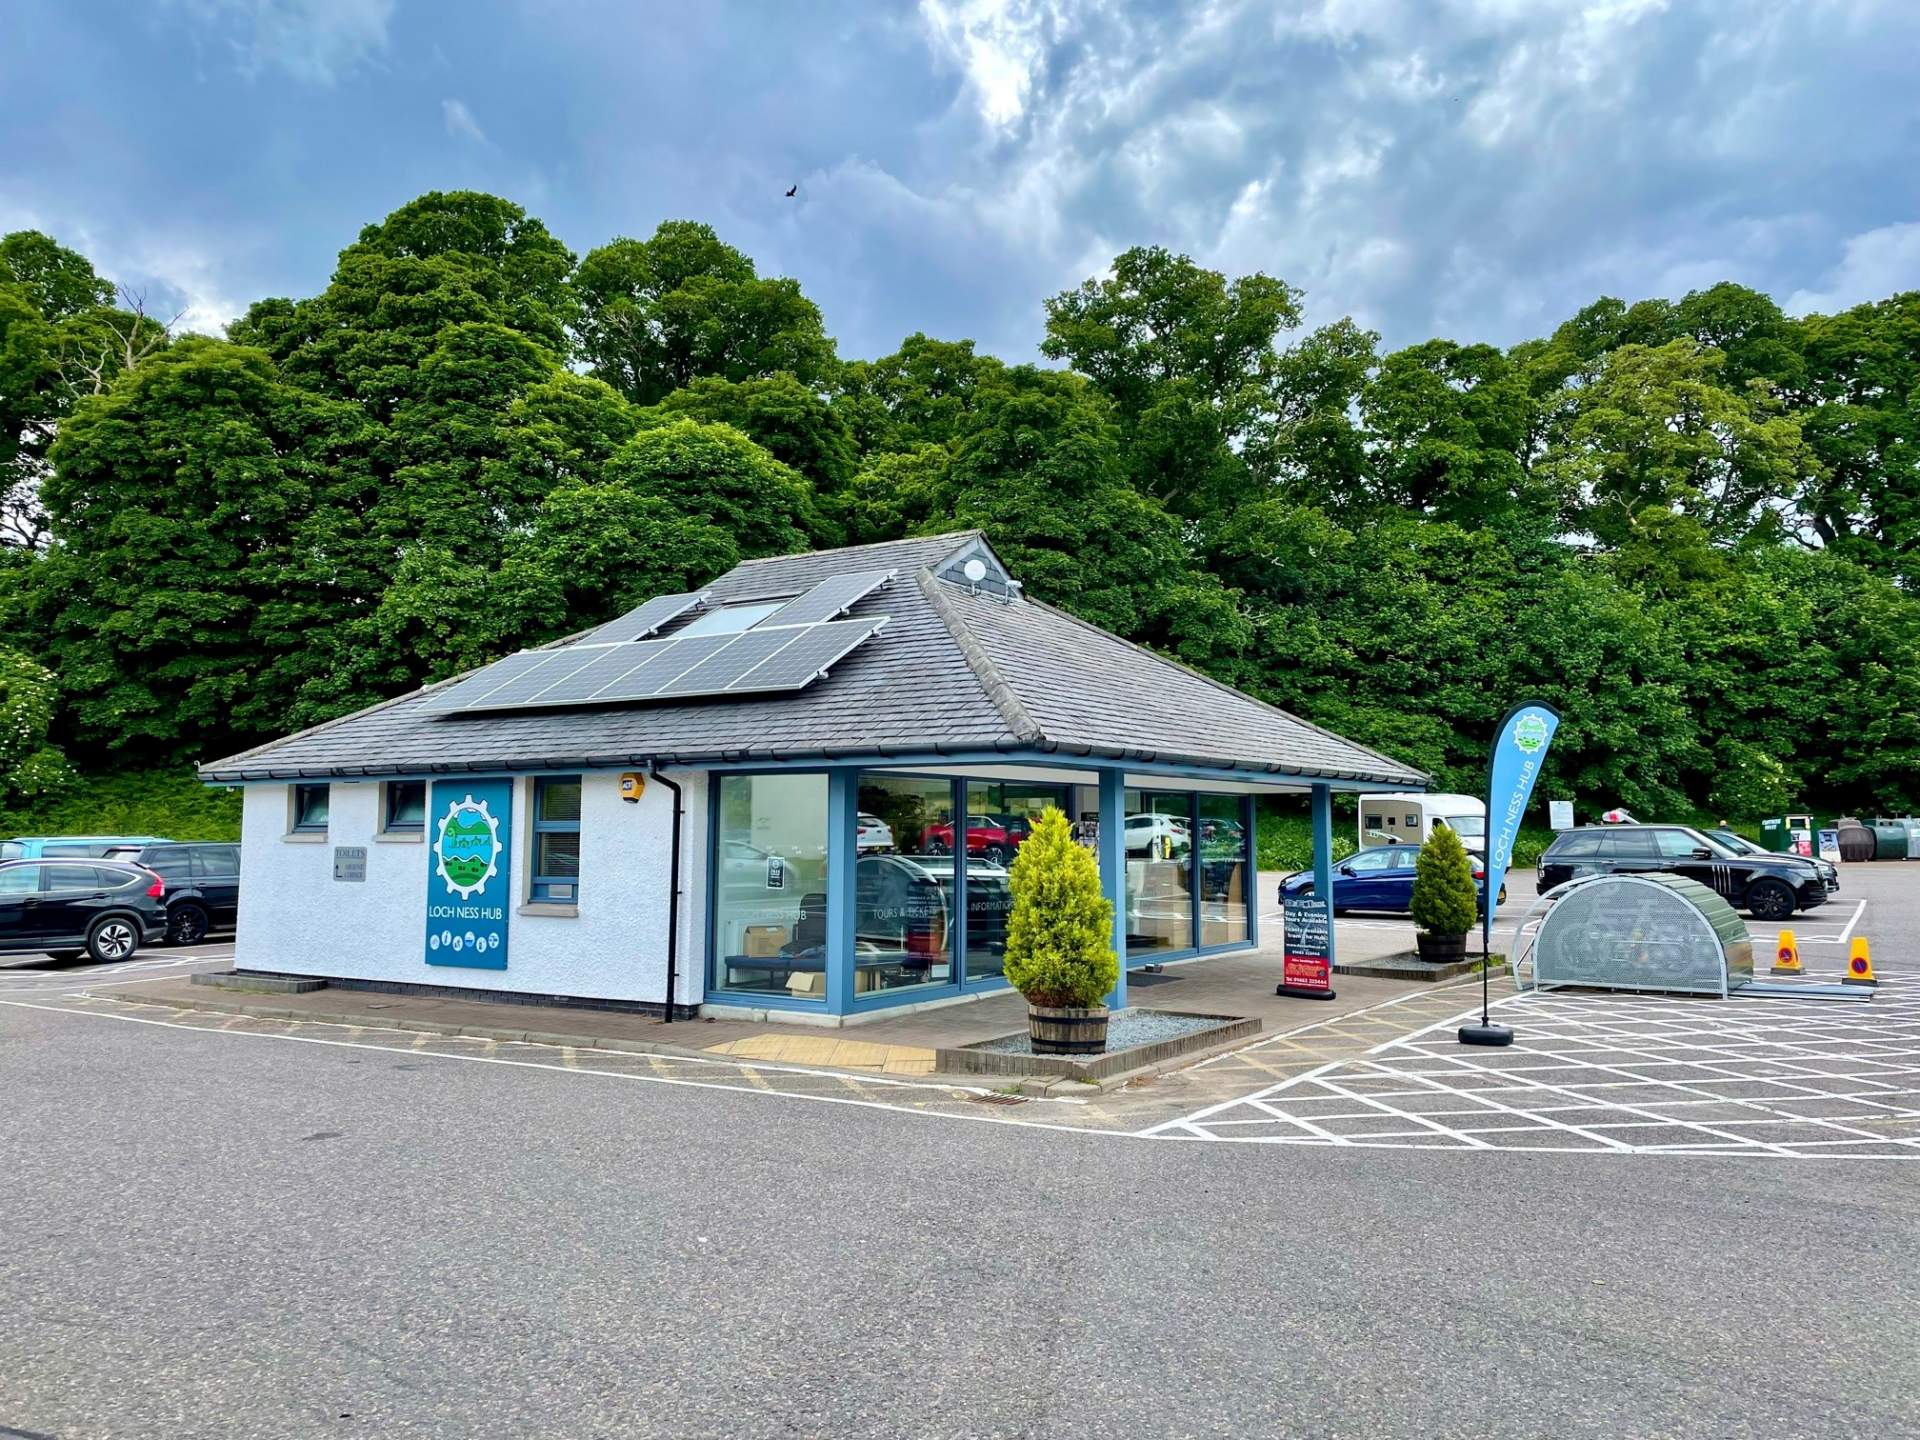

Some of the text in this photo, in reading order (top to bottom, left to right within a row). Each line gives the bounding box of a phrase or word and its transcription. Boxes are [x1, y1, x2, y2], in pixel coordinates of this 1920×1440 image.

[1493, 760, 1535, 870] LOCH NESS HUB
[429, 906, 502, 920] LOCH NESS HUB
[872, 907, 897, 920] TOURS
[1304, 911, 1328, 919] Evening
